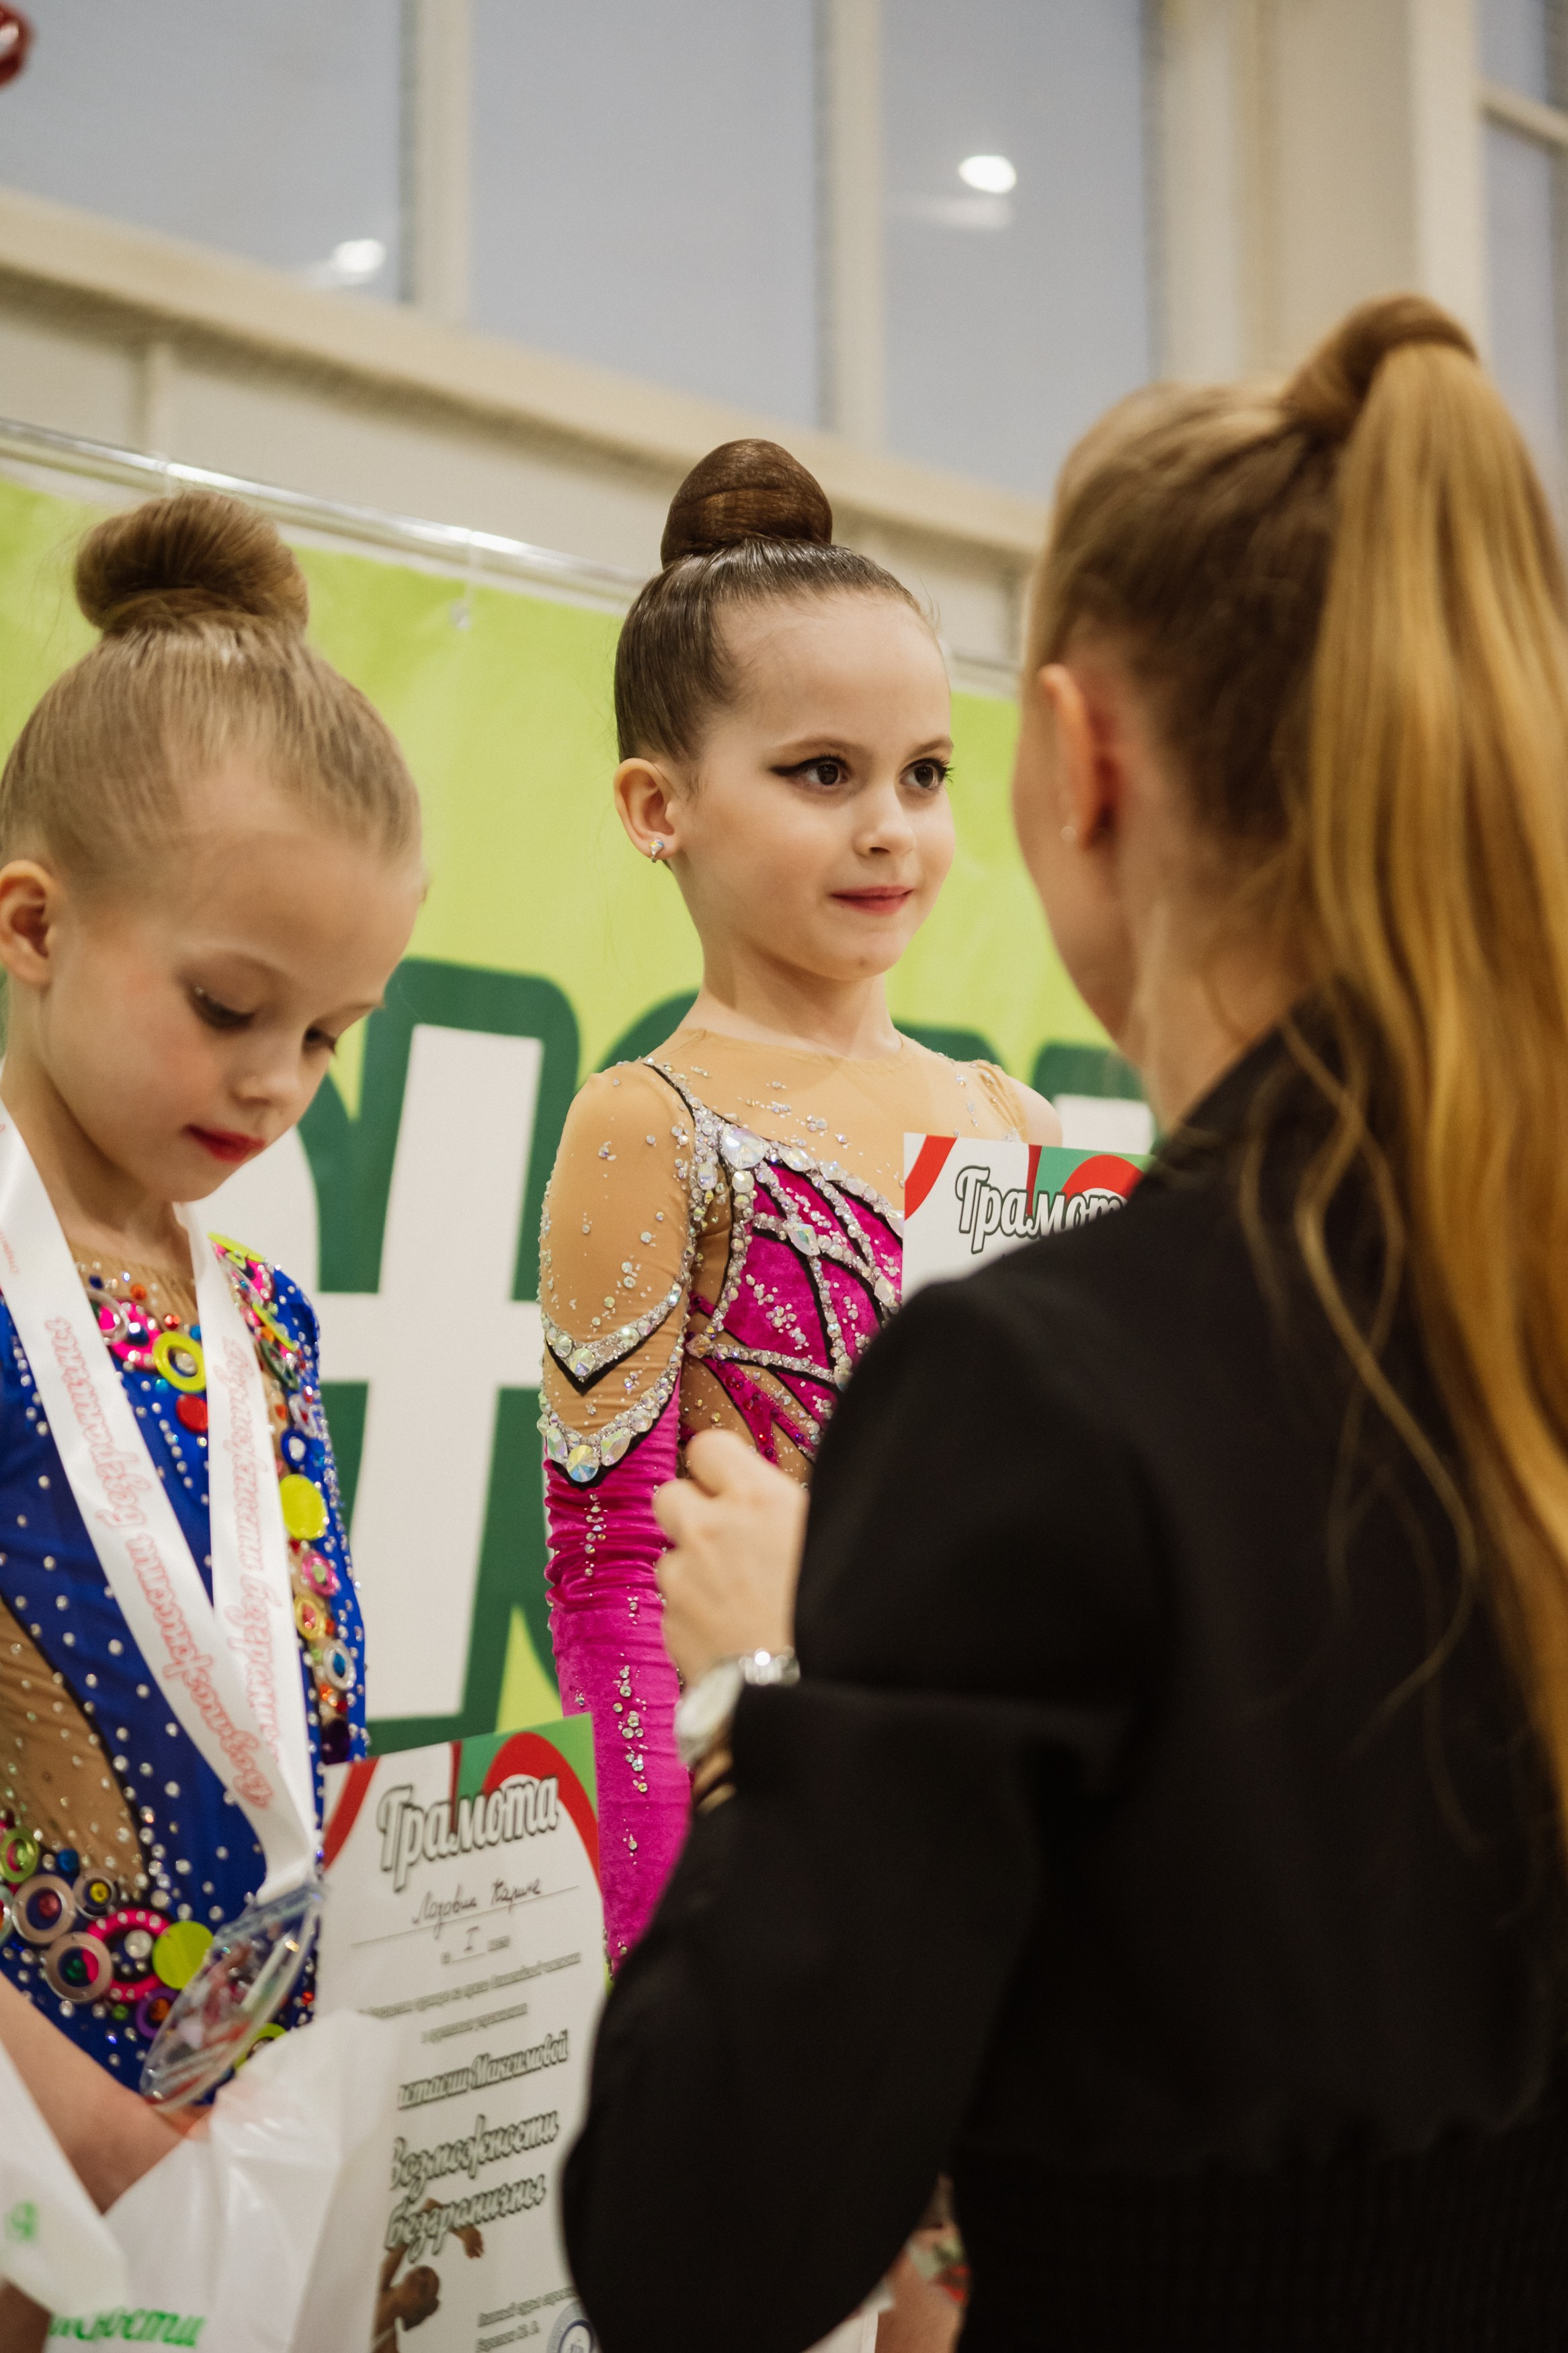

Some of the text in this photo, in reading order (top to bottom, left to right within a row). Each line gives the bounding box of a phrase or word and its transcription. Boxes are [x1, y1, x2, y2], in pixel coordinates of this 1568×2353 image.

[954, 1165, 1125, 1254] Грамо
[376, 1774, 559, 1893] Грамота
[470, 2029, 568, 2089] Максимовой
